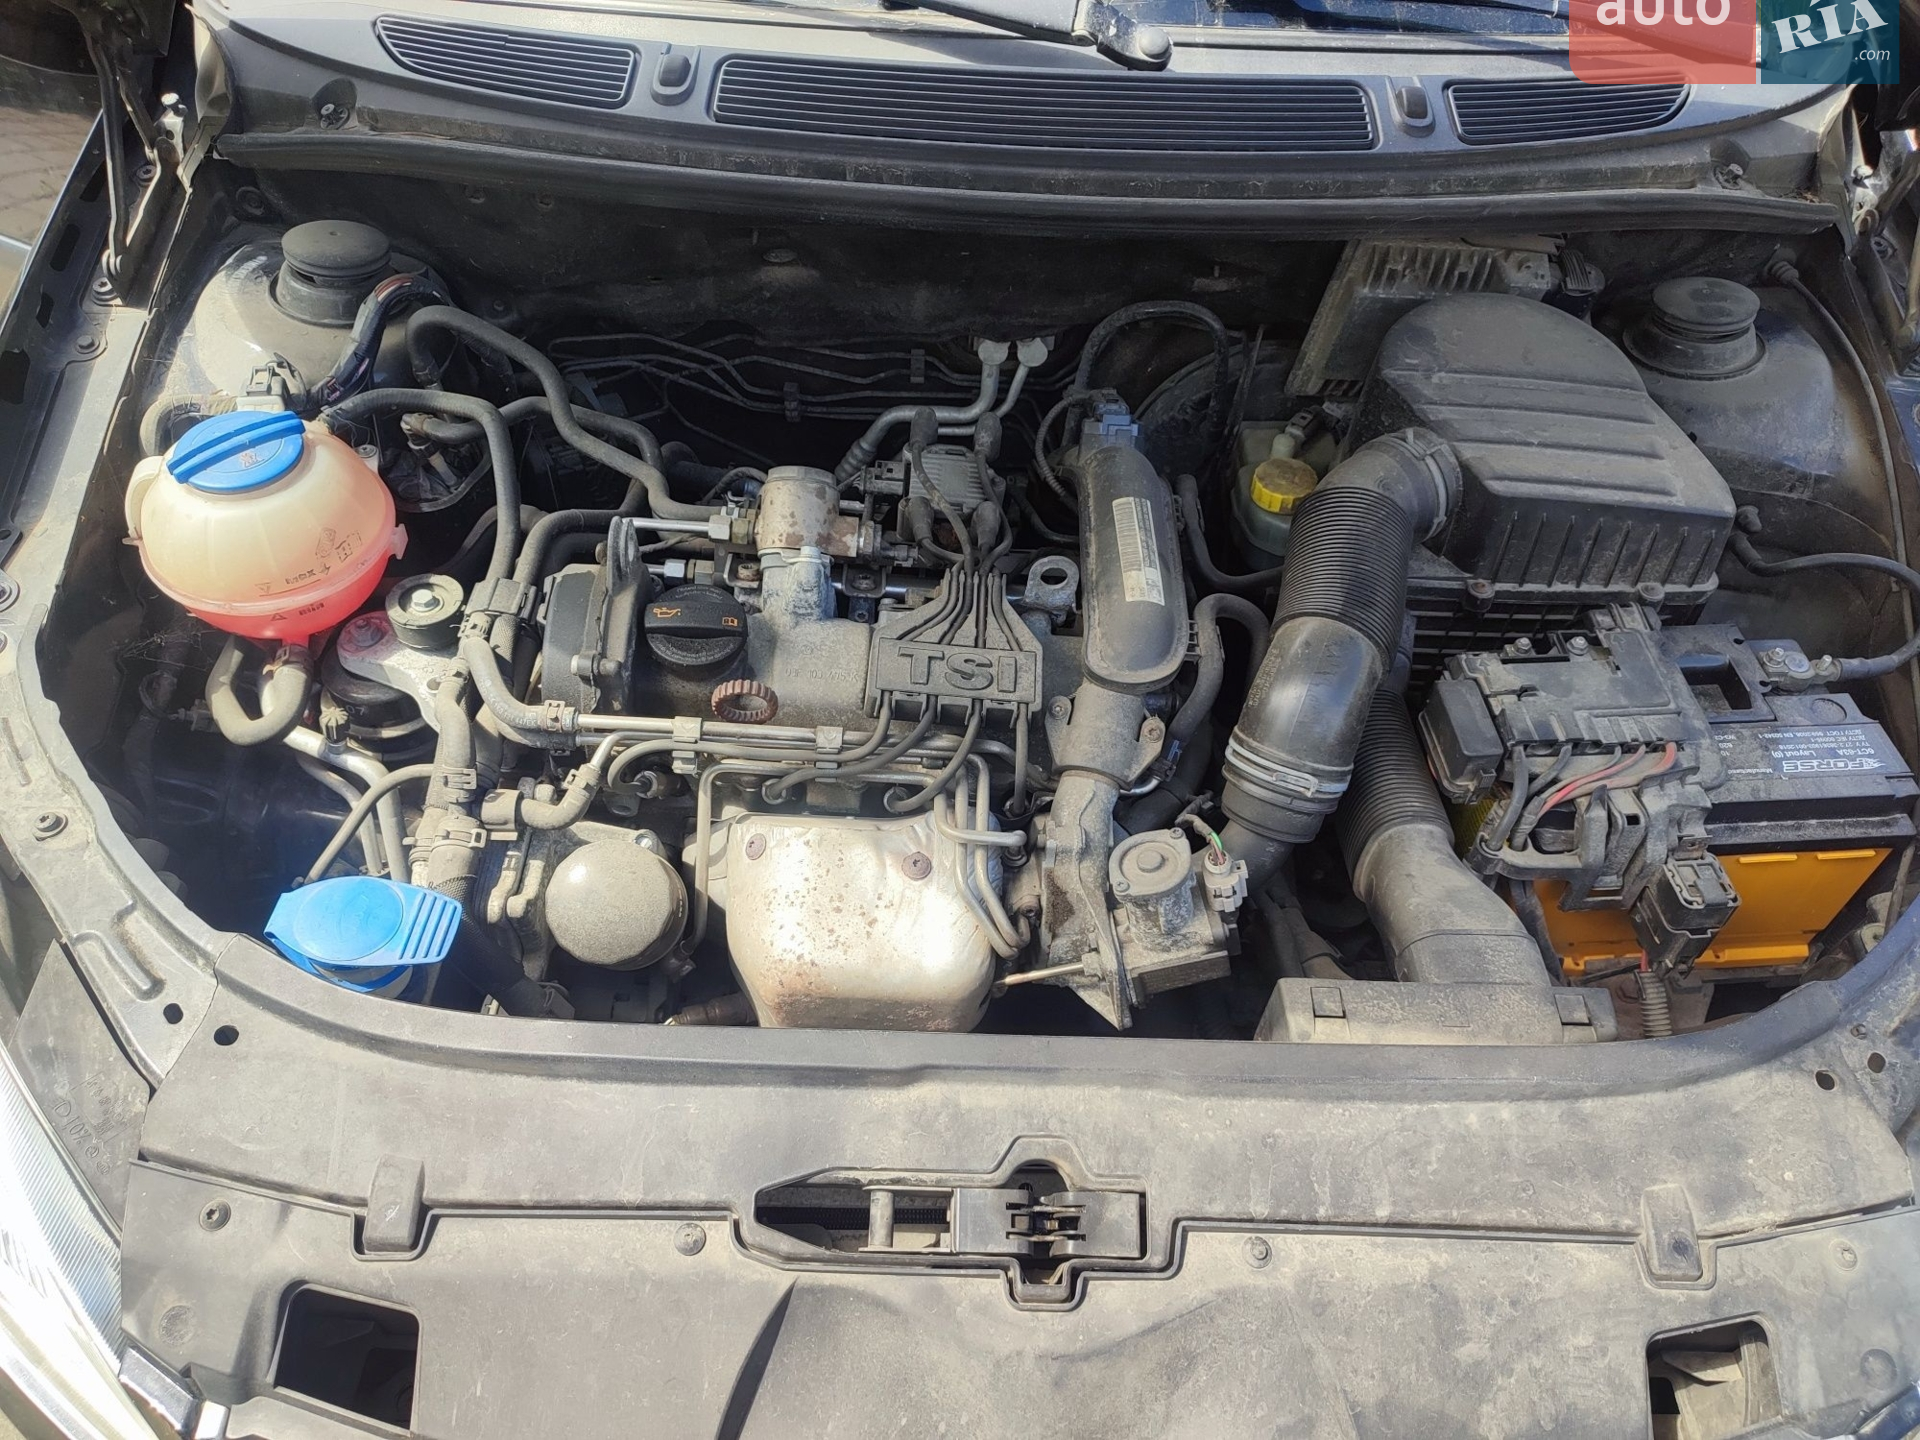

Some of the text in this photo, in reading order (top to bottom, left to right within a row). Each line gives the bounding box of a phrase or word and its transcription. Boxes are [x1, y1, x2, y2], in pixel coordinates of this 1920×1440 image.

[897, 646, 1018, 693] TSI
[1785, 748, 1817, 759] Layout
[1782, 758, 1867, 772] FORSE
